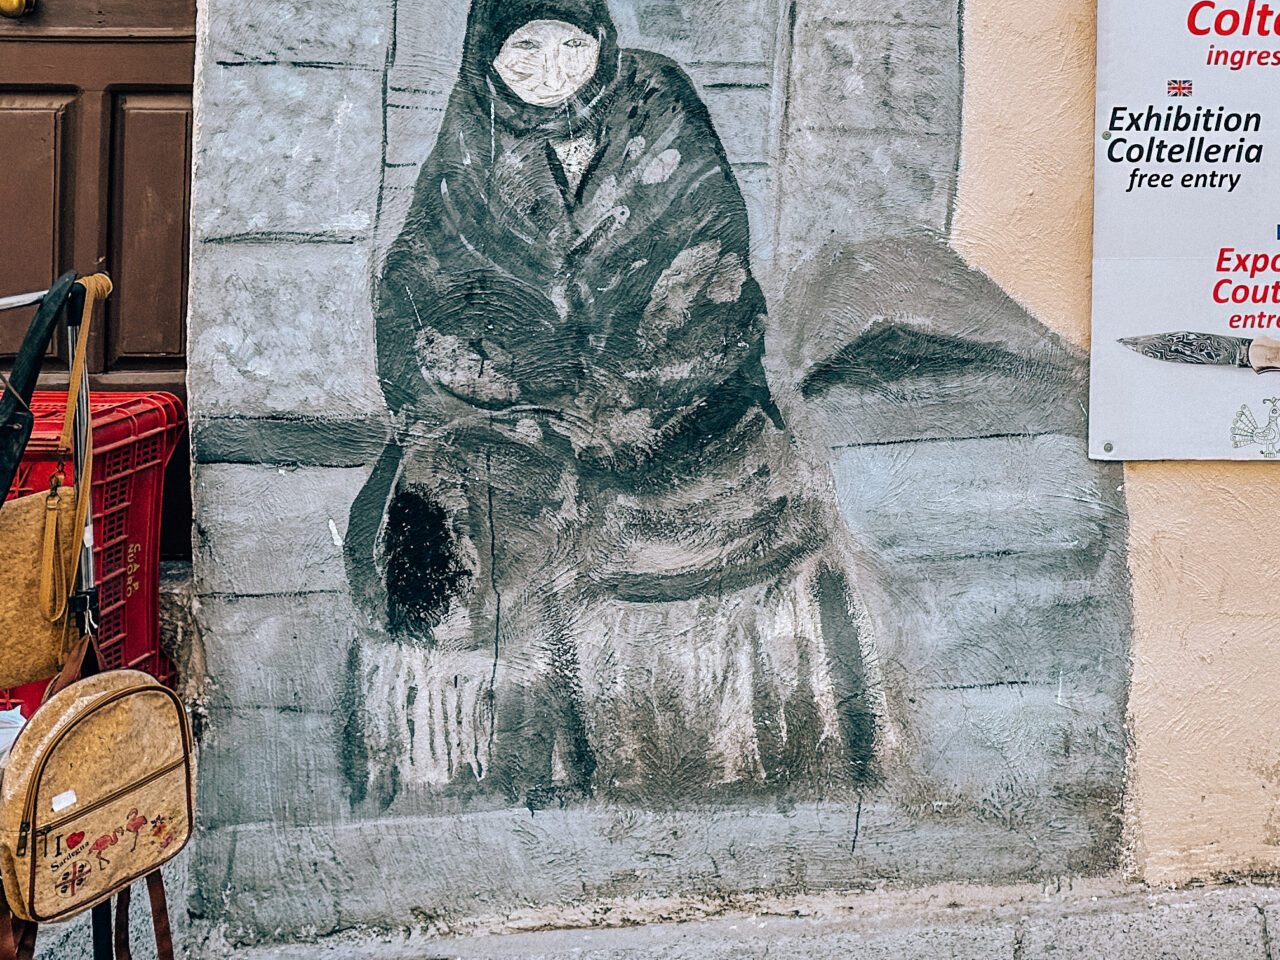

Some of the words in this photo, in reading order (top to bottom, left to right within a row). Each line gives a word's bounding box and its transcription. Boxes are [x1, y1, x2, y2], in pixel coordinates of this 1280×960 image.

[1109, 106, 1261, 132] Exhibition
[1107, 138, 1263, 163] Coltelleria
[1126, 168, 1174, 192] free
[1180, 170, 1241, 192] entry
[50, 841, 90, 873] Sardegna
[55, 833, 64, 858] I
